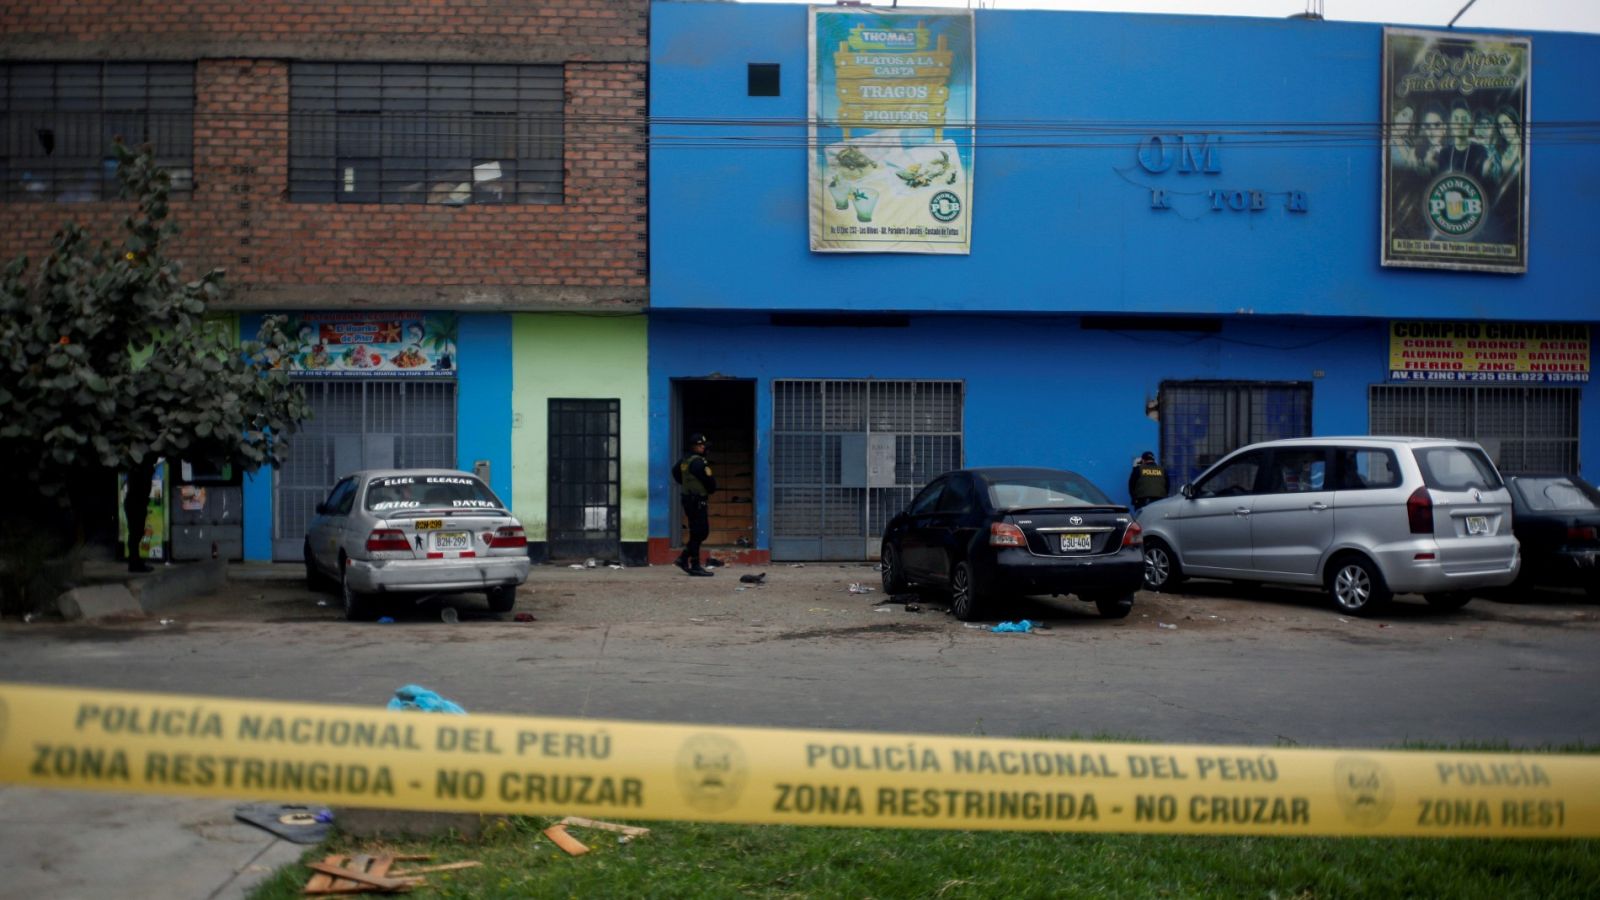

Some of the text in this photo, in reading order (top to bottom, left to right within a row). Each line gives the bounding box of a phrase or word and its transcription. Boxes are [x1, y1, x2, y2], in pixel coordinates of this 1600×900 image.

[862, 31, 915, 42] THOMAS
[855, 56, 934, 65] PLATOS A LA
[874, 66, 915, 75] CARTA
[860, 86, 928, 99] TRAGOS
[863, 110, 928, 123] PIQUEOS
[1434, 179, 1476, 197] THOMAS
[1394, 323, 1588, 340] COMPRO CHATARRA
[1404, 339, 1588, 351] COBRE BRONCE ACERO
[1402, 351, 1587, 361] ALUMINIO PLOMO BATERIAS
[1405, 361, 1587, 372] FIERRO ZINC NIQUEL
[1392, 371, 1412, 381] AV.
[1413, 371, 1426, 381] EL
[1427, 371, 1454, 381] ZINC
[384, 477, 474, 487] ELIEL ELEAZAR
[452, 499, 495, 508] DAYRA
[76, 702, 612, 760] POLICÍA NACIONAL DEL PERÚ
[805, 741, 1278, 782] POLICÍA NACIONAL DEL PERÚ
[30, 744, 131, 781] ZONA
[144, 750, 396, 797] RESTRINGIDA
[436, 769, 485, 801] NO
[499, 772, 644, 808] CRUZAR
[773, 783, 864, 815] ZONA
[877, 786, 1099, 822] RESTRINGIDA
[1135, 795, 1177, 824] NO
[1190, 797, 1311, 825] CRUZAR
[1417, 799, 1492, 827] ZONA
